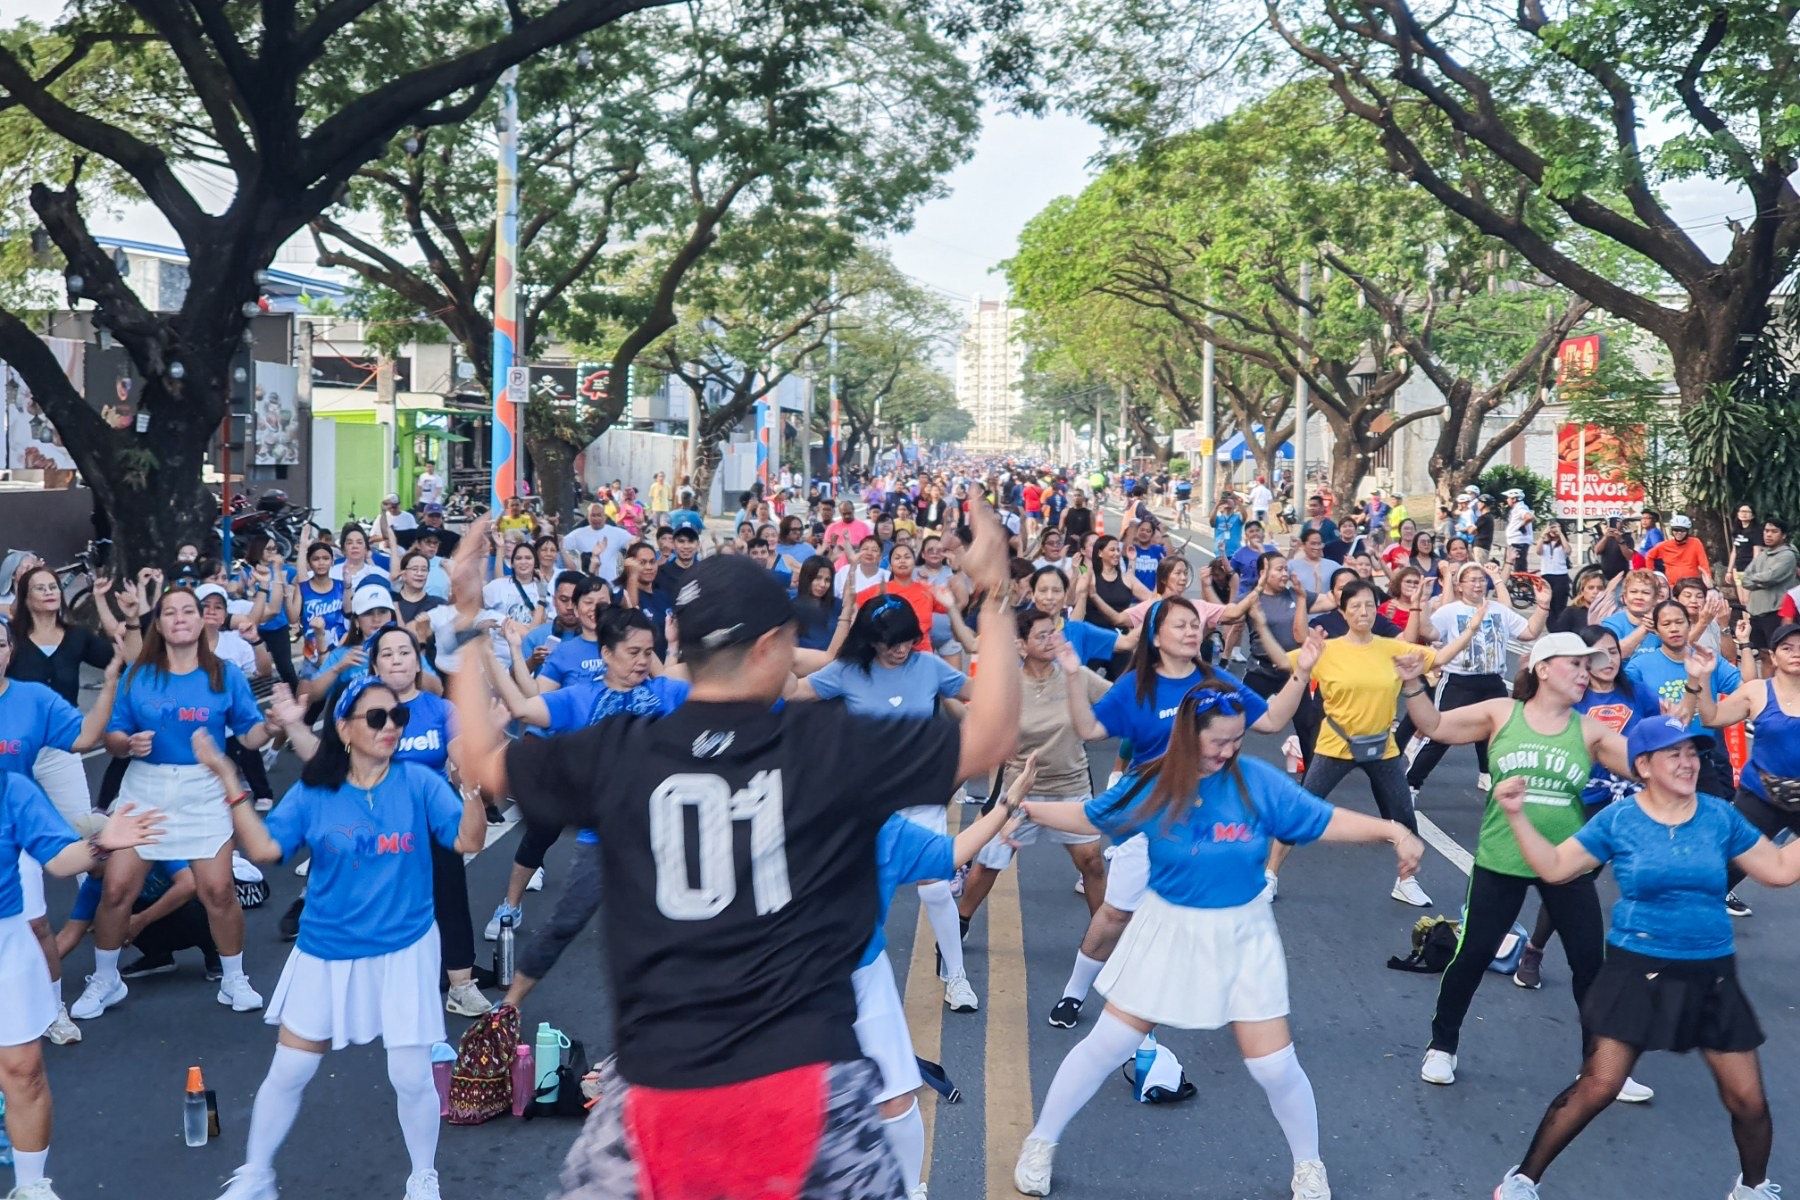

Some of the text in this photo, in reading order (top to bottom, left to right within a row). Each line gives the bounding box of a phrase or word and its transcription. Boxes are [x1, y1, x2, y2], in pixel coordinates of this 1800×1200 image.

[1560, 473, 1577, 482] DIP
[1560, 482, 1628, 496] FLAVOR
[1563, 507, 1597, 516] ORER
[1497, 750, 1539, 774] BORN
[1545, 753, 1566, 774] TO
[354, 831, 416, 856] MMC
[649, 769, 792, 920] 01
